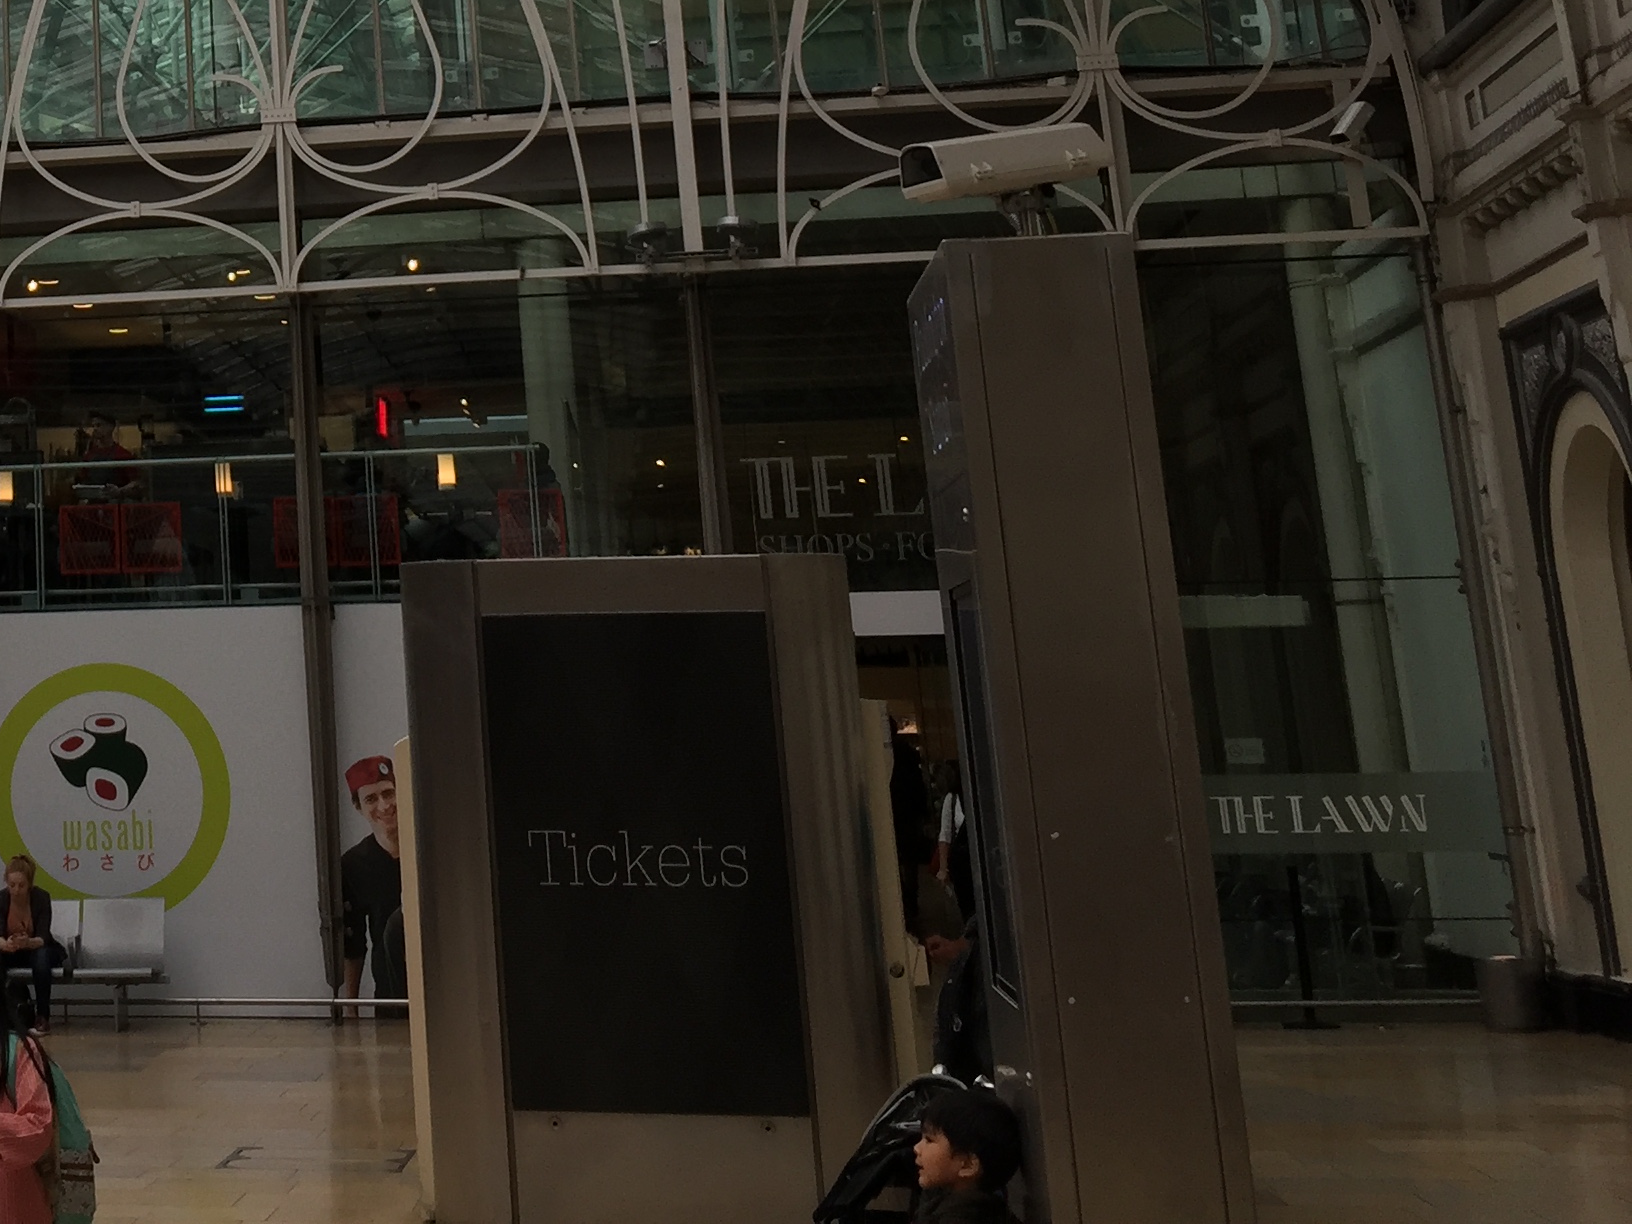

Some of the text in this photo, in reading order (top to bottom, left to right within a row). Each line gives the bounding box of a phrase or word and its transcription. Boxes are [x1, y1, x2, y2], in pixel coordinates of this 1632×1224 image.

[739, 456, 854, 519] THE
[759, 532, 875, 562] SHOPS
[63, 809, 154, 852] wasabi
[1210, 794, 1428, 834] THE LAWN
[63, 853, 155, 872] わさび
[528, 830, 749, 887] Tickets
